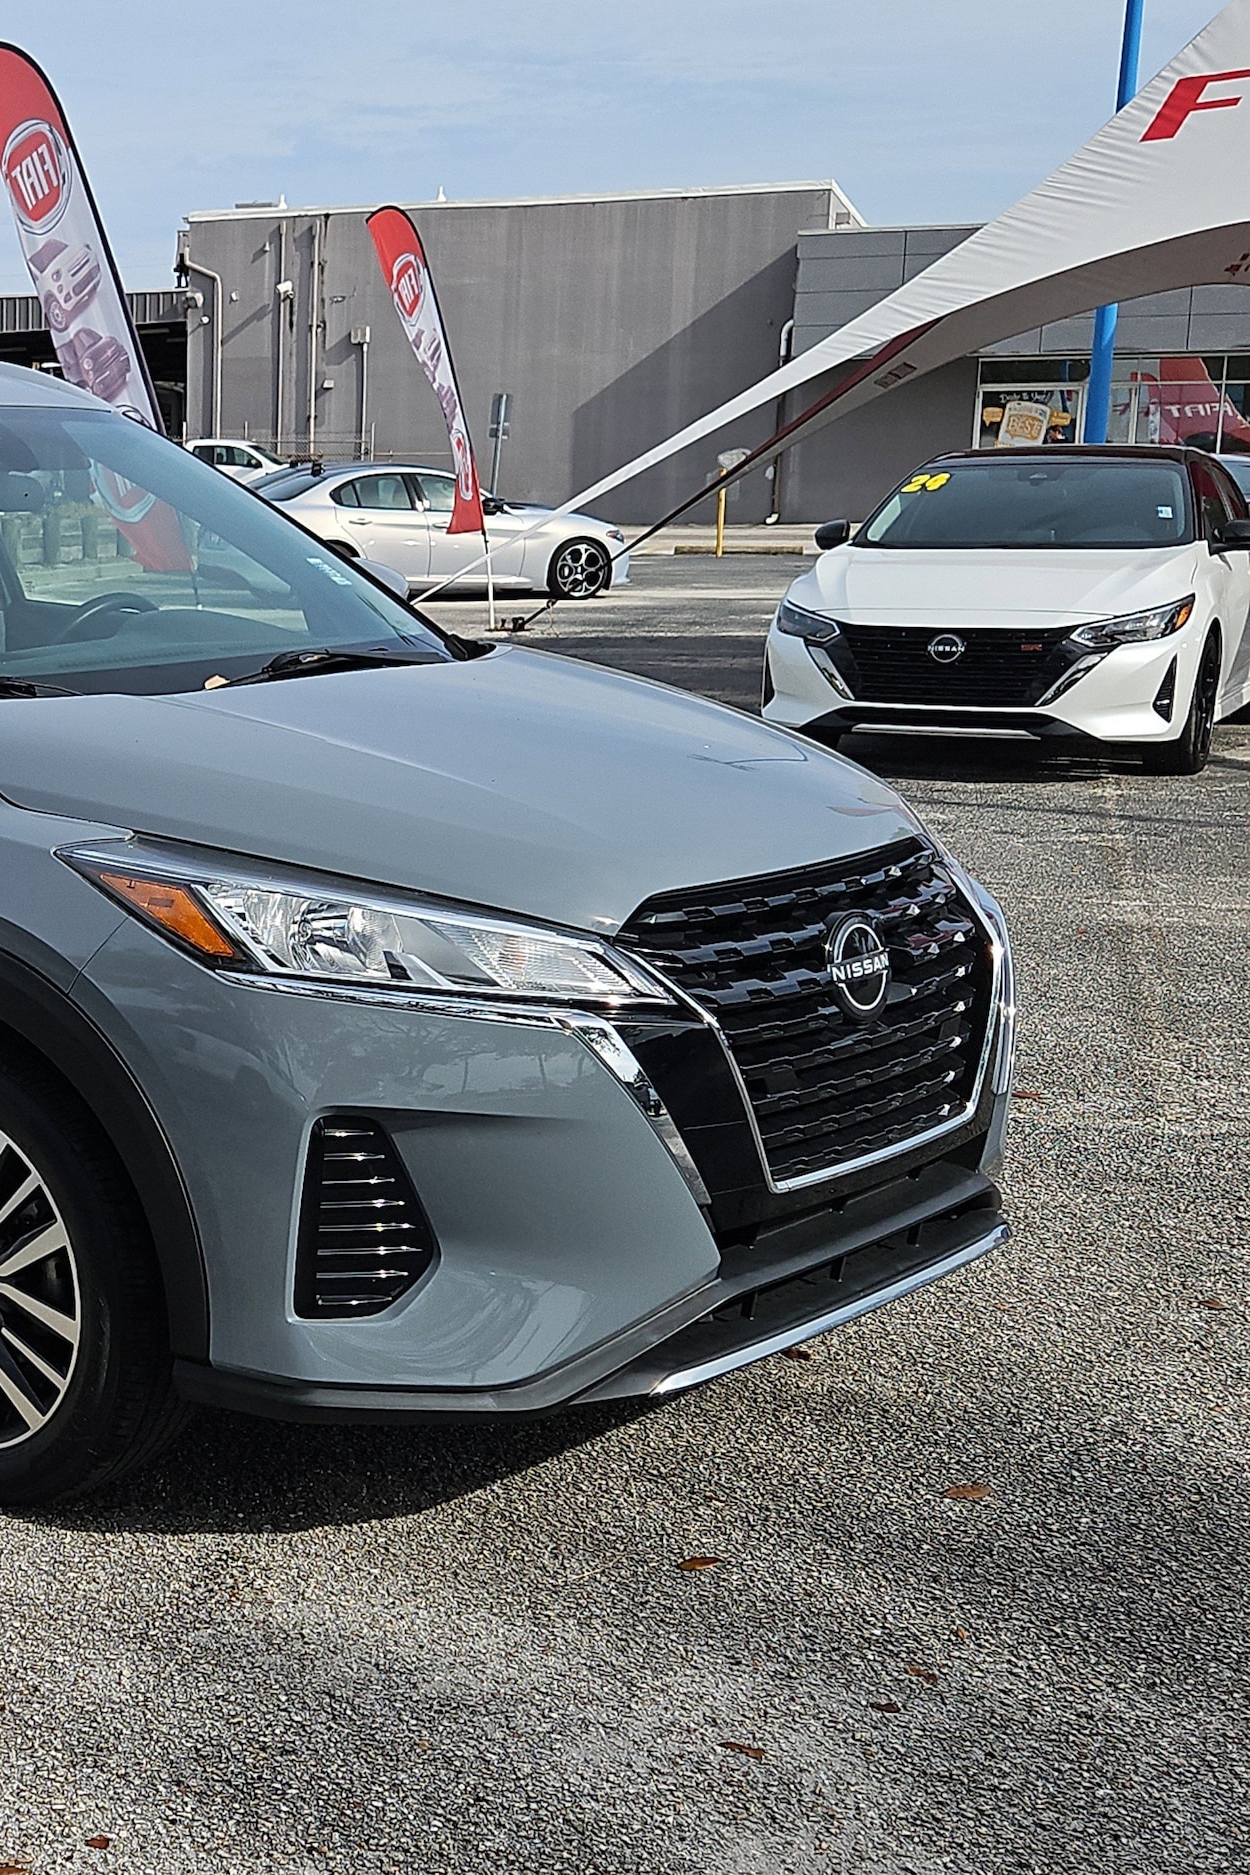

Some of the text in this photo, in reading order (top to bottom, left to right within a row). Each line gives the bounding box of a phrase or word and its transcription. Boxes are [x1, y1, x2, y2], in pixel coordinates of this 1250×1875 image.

[899, 471, 952, 493] 24
[927, 644, 965, 653] NISSAN
[831, 952, 890, 981] NISSAN
